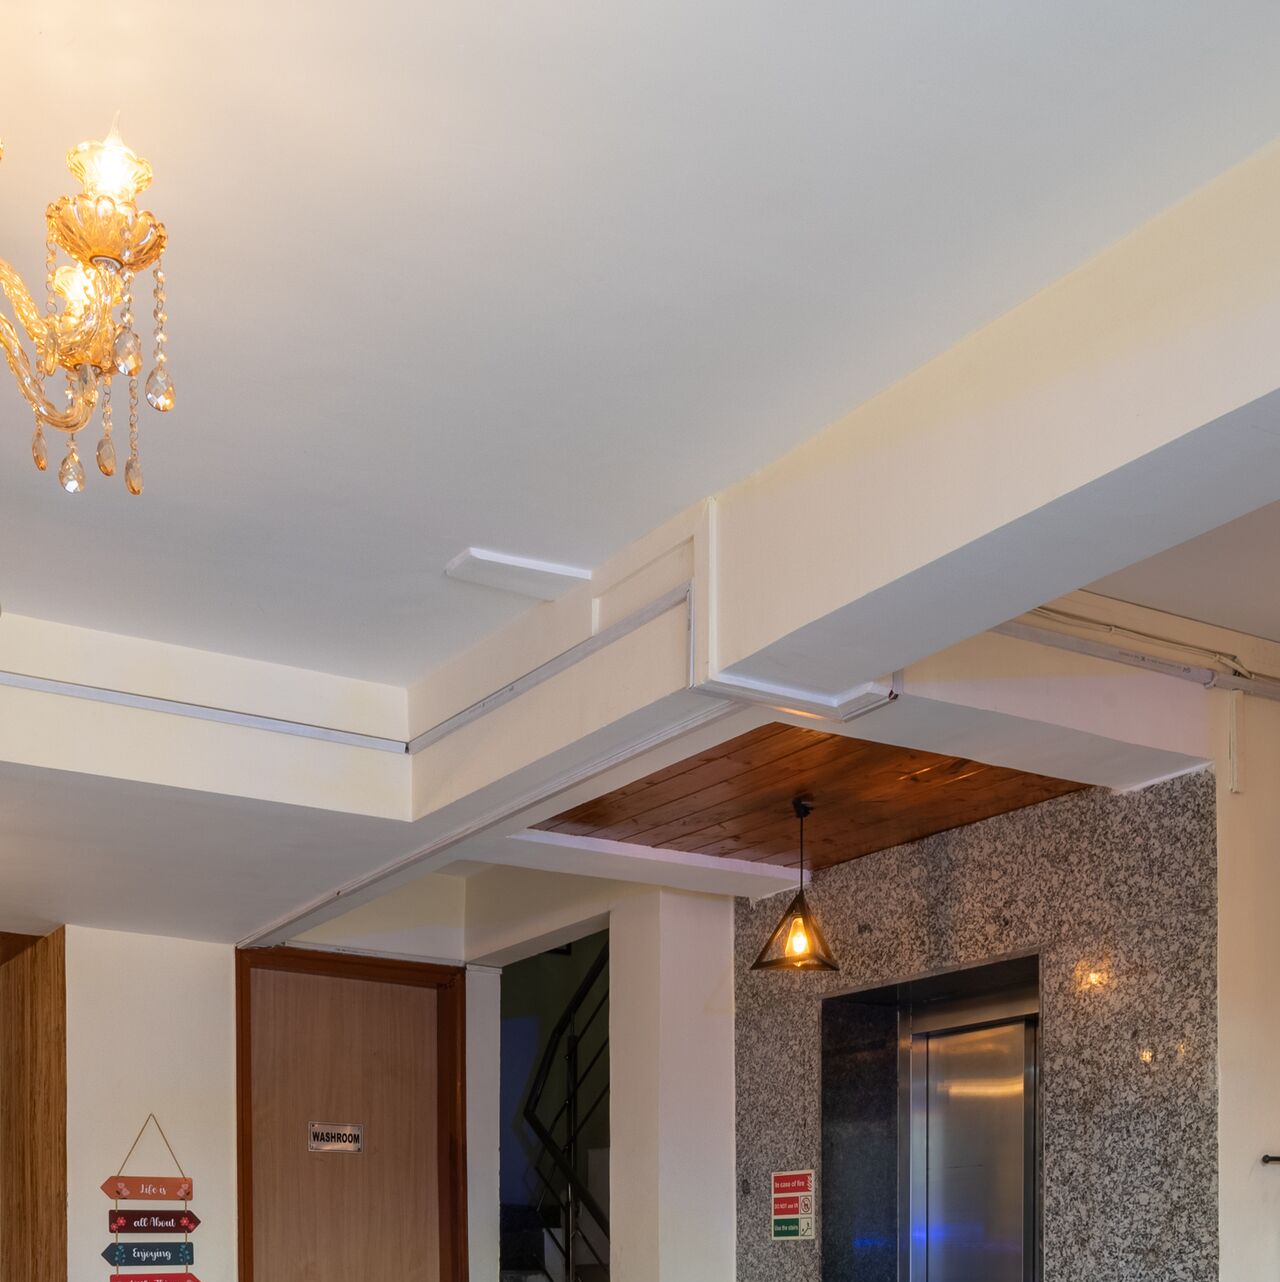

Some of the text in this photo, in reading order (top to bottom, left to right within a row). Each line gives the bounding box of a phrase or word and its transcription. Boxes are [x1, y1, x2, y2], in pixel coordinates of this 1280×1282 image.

[312, 1131, 360, 1144] WASHROOM
[140, 1184, 167, 1195] Life is
[133, 1217, 176, 1228] all About
[132, 1248, 172, 1261] Enjoying
